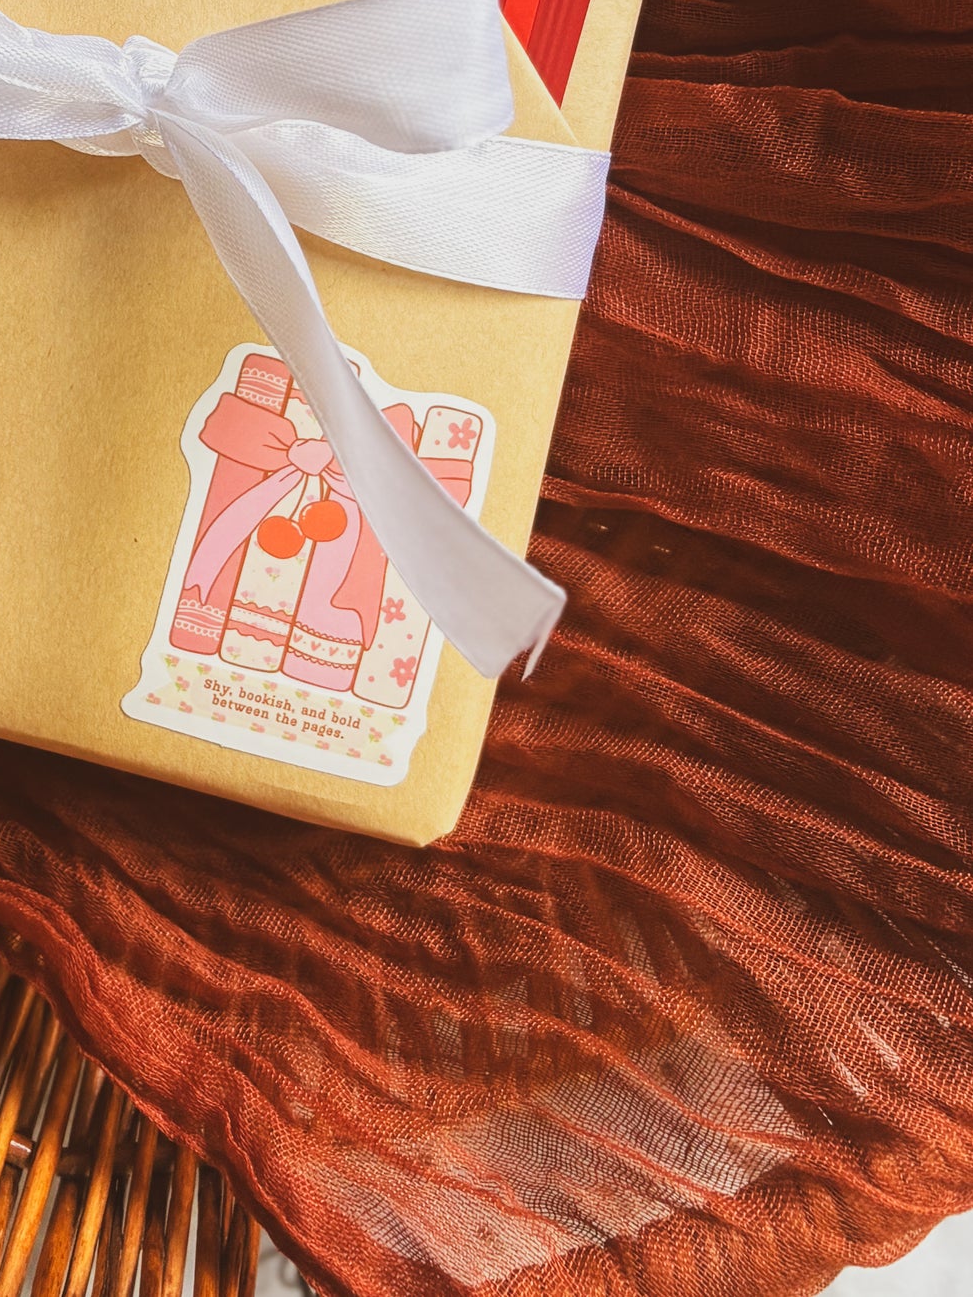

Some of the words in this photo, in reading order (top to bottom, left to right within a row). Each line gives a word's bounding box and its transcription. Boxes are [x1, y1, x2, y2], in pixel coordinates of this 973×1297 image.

[211, 694, 270, 720] between
[276, 713, 298, 727] the
[301, 720, 345, 740] pages.
[238, 686, 296, 714] bookish,
[300, 705, 326, 721] and
[331, 712, 362, 730] bold
